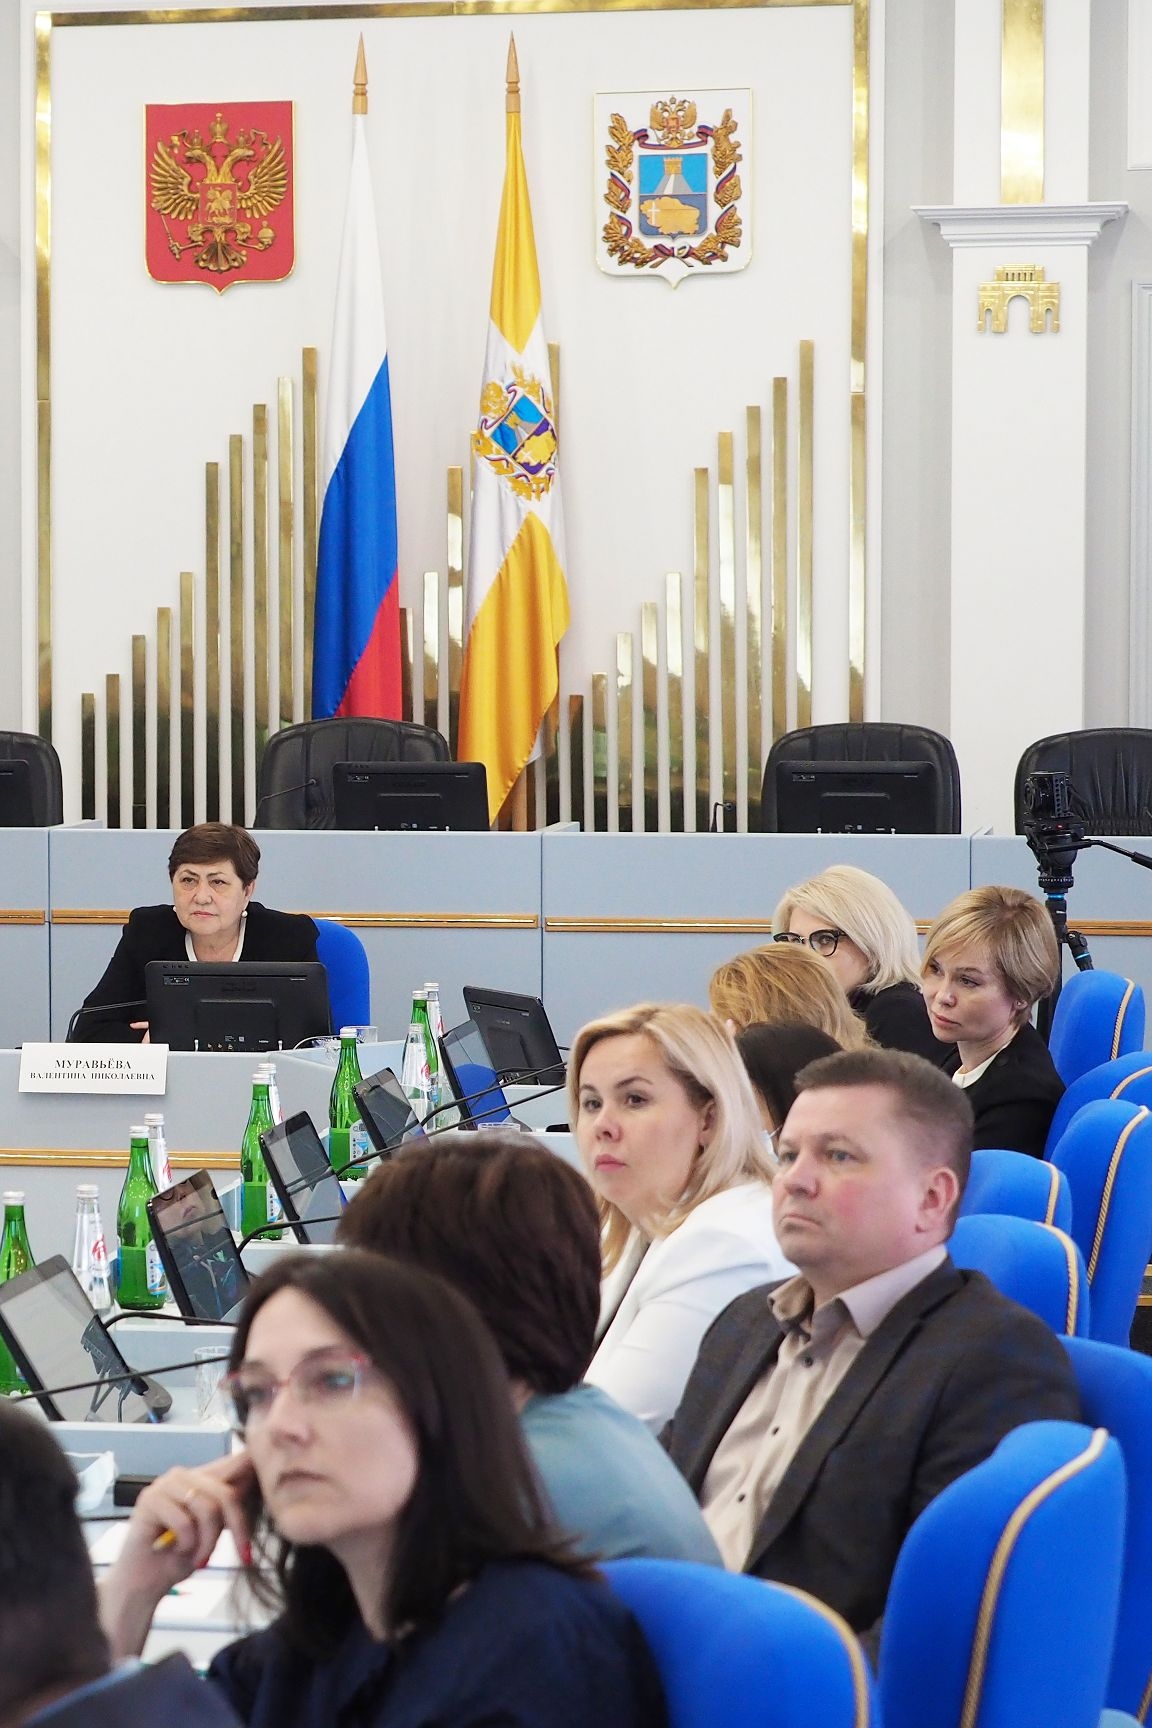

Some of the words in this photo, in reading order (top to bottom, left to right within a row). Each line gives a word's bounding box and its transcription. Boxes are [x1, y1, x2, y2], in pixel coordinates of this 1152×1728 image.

[54, 1058, 132, 1070] МУРАВЬЁВА
[30, 1072, 86, 1080] ВАЛЕНТИНА
[91, 1072, 155, 1080] НИКОЛАЕВНА
